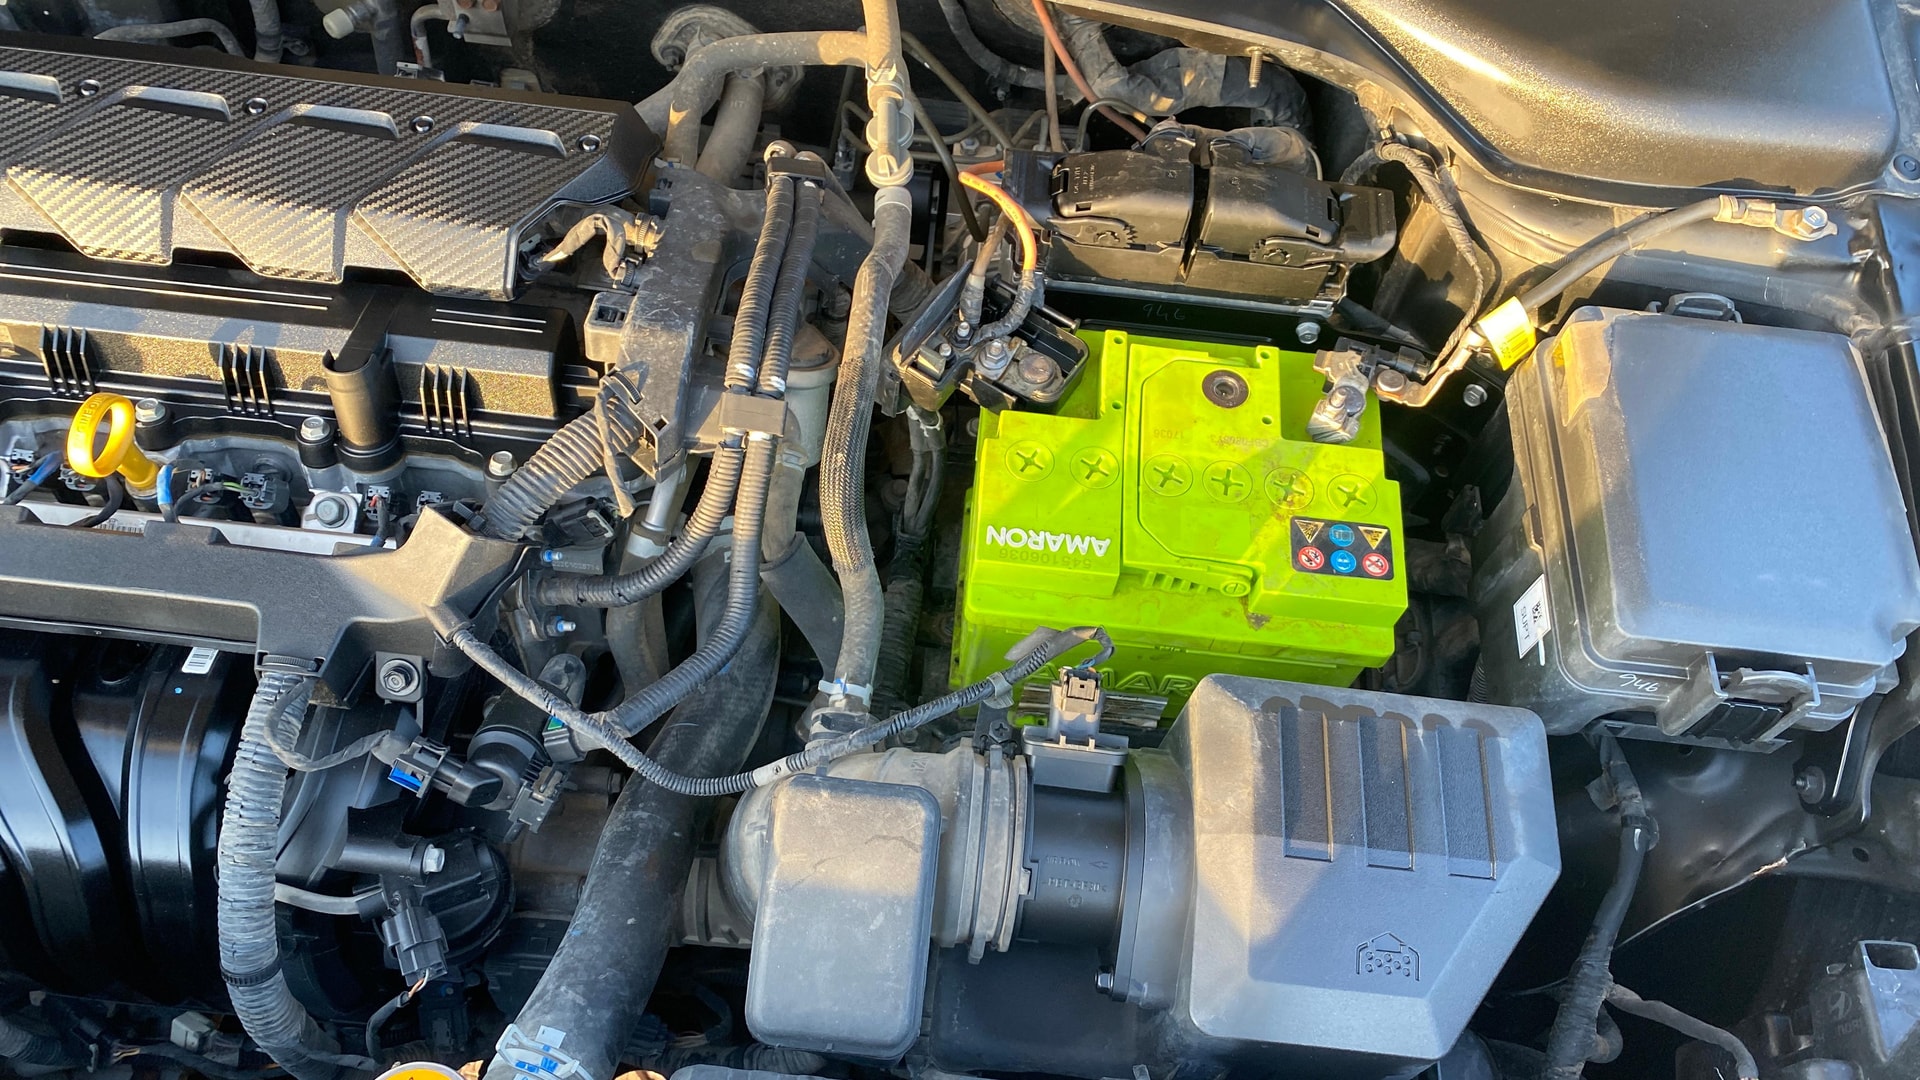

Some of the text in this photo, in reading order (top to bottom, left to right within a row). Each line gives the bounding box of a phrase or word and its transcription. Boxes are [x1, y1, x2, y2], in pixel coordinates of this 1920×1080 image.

[986, 525, 1111, 557] AMARON
[998, 548, 1092, 570] 545106036
[1618, 673, 1660, 692] 946
